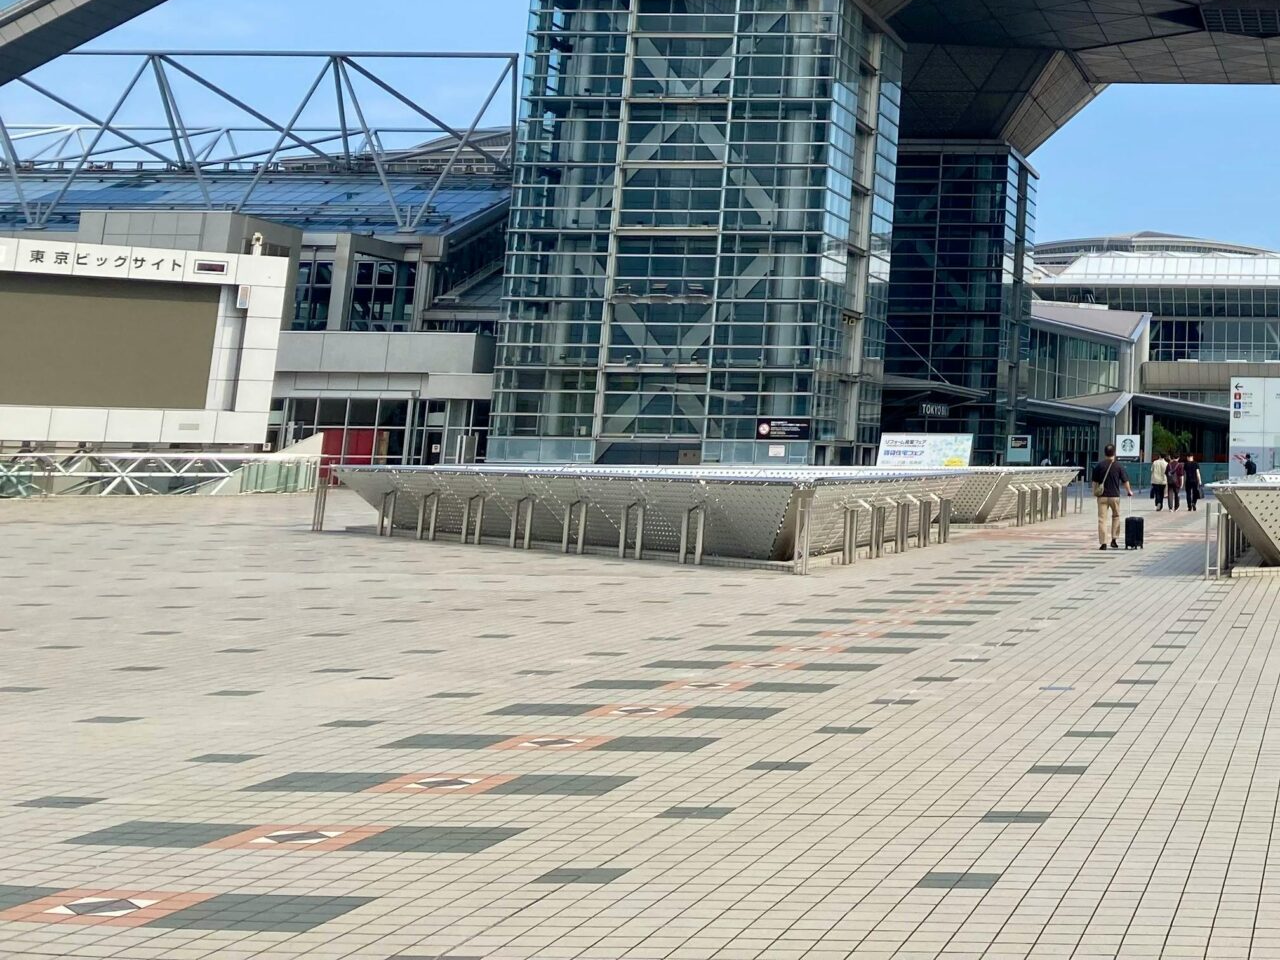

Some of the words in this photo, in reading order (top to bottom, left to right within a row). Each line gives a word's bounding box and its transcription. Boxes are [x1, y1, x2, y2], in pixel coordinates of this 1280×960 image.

[29, 249, 183, 272] 東京ビッグサイト
